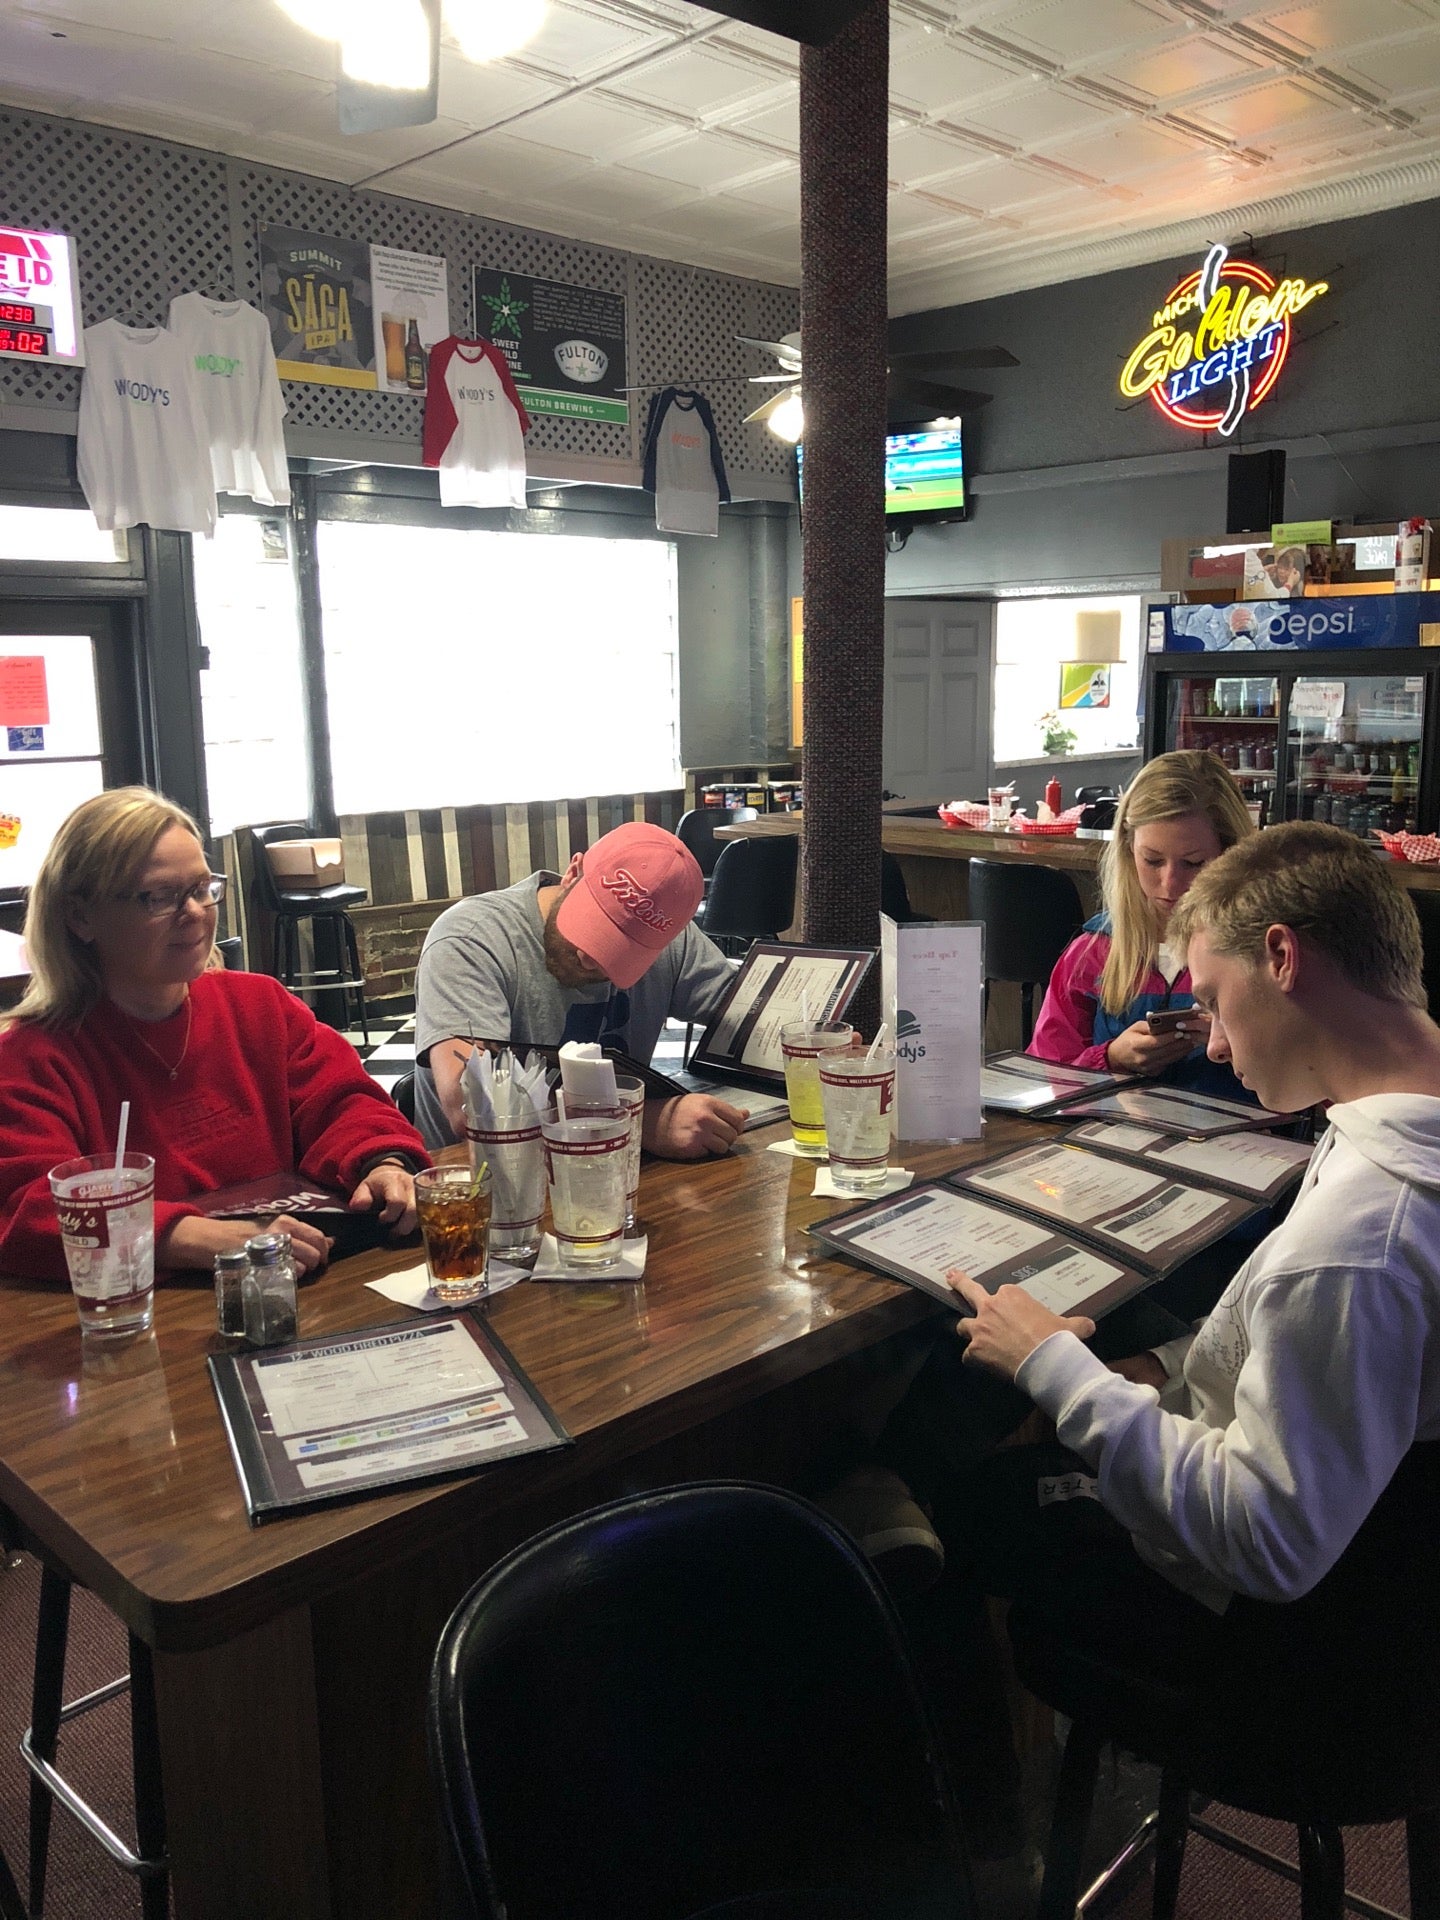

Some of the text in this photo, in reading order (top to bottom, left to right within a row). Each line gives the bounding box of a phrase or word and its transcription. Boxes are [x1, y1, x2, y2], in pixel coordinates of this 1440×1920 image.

[289, 249, 343, 272] SUMMIT
[311, 334, 331, 345] IPA
[491, 338, 520, 350] SWEET
[1119, 278, 1329, 397] Golden
[507, 361, 522, 370] INE
[558, 346, 605, 369] FULTON
[1167, 322, 1284, 405] LIGHT
[520, 397, 594, 414] FULTON BREWING
[1269, 606, 1354, 641] pepsi
[897, 1041, 926, 1063] dy's
[311, 1343, 351, 1359] WOOD
[352, 1336, 388, 1352] FIRED
[389, 1330, 425, 1346] PIZZA
